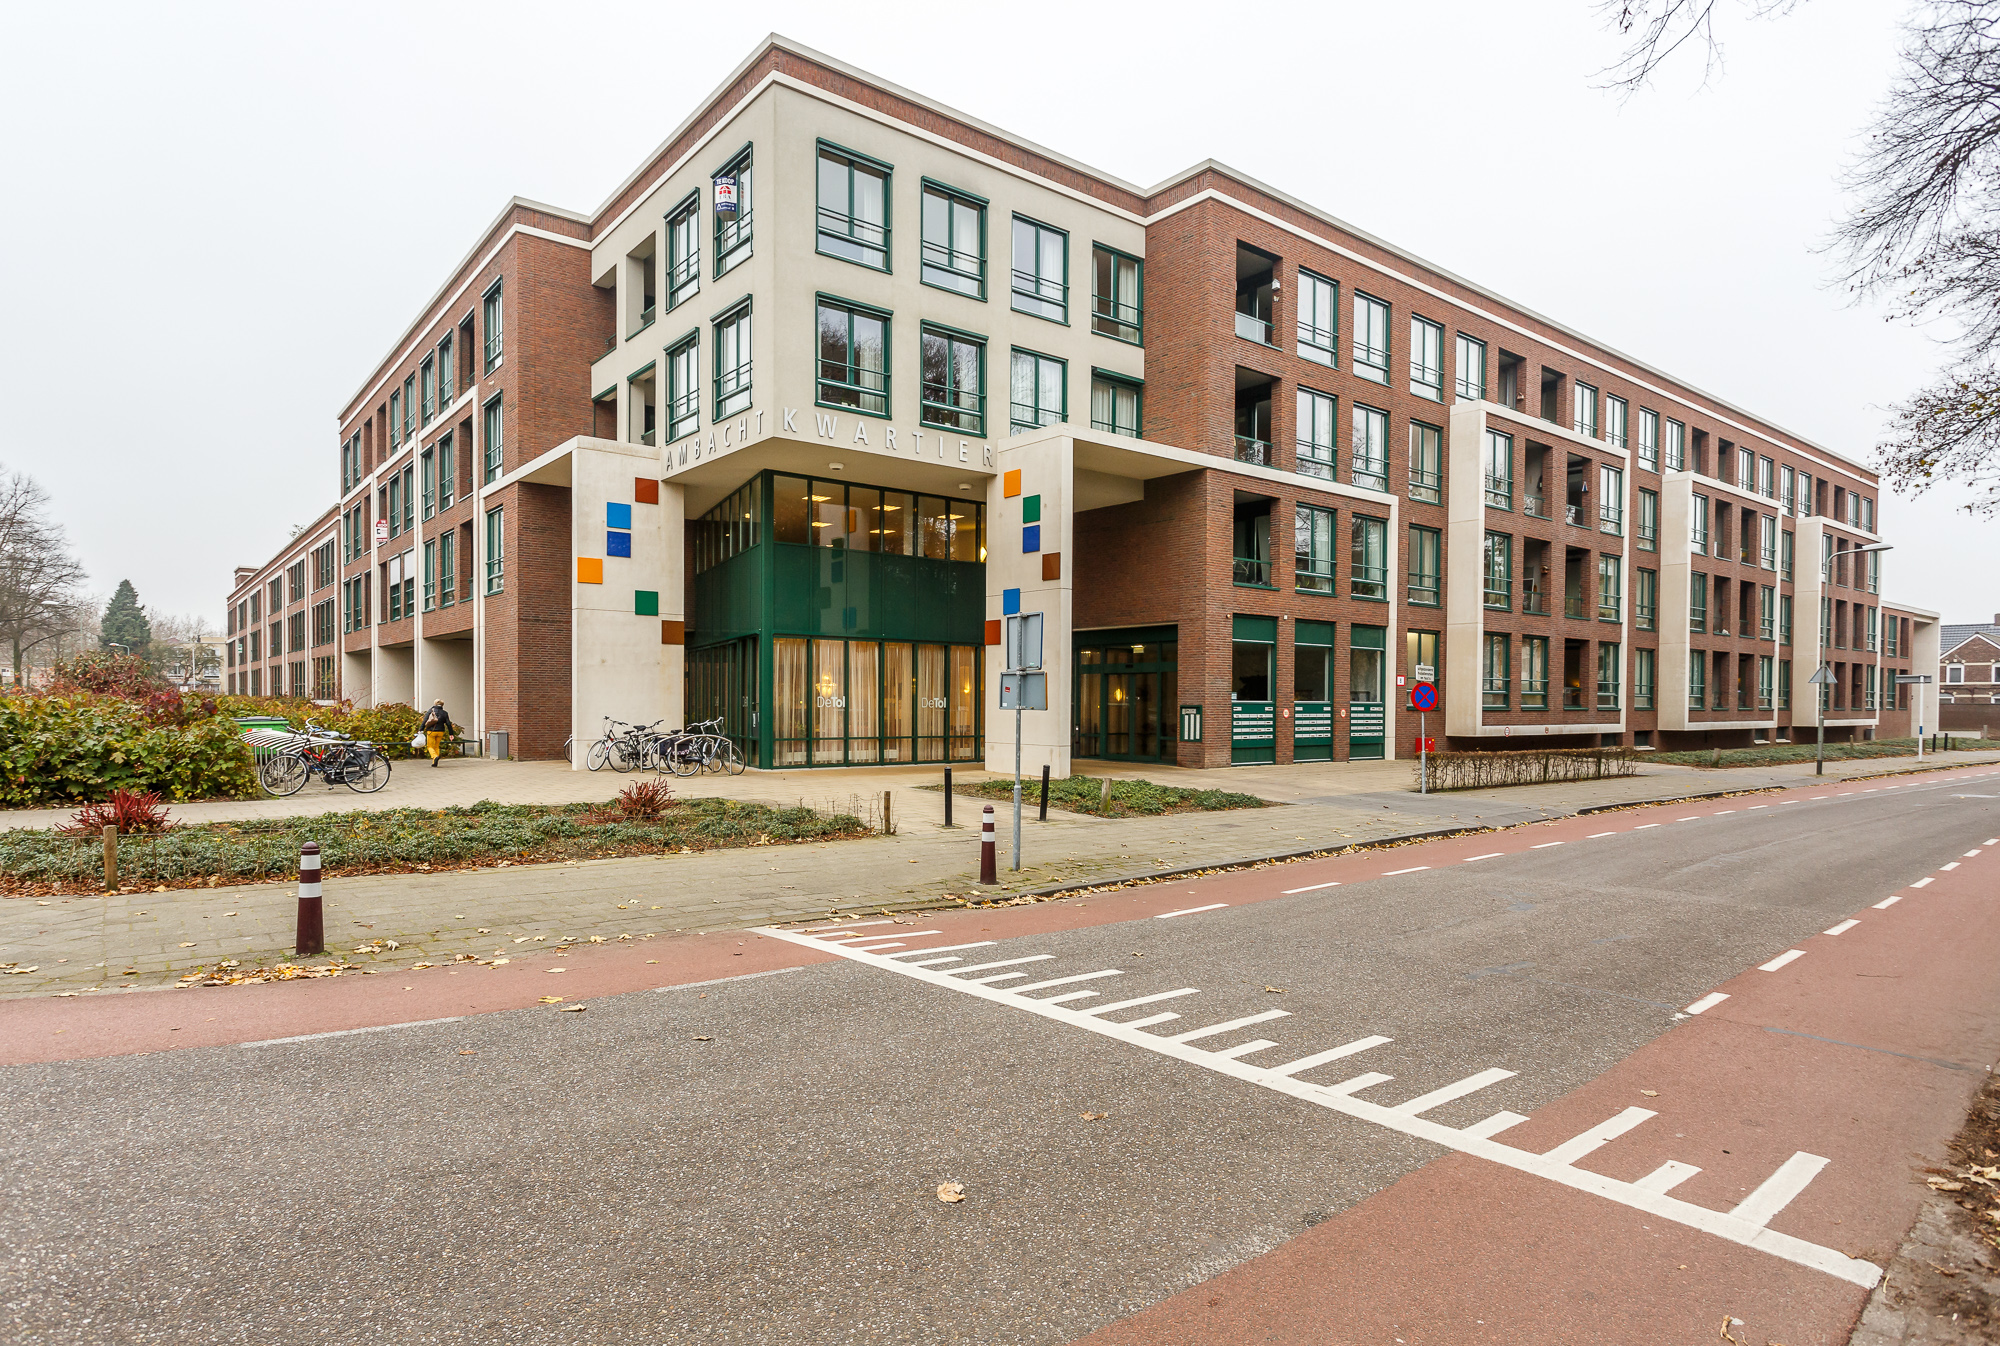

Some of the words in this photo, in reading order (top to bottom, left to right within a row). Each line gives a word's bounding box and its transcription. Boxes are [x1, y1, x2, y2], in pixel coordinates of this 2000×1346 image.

[666, 409, 764, 472] AMBACHT
[783, 406, 994, 468] KWARTIER
[816, 696, 846, 708] DeTol
[921, 697, 946, 708] DeTol
